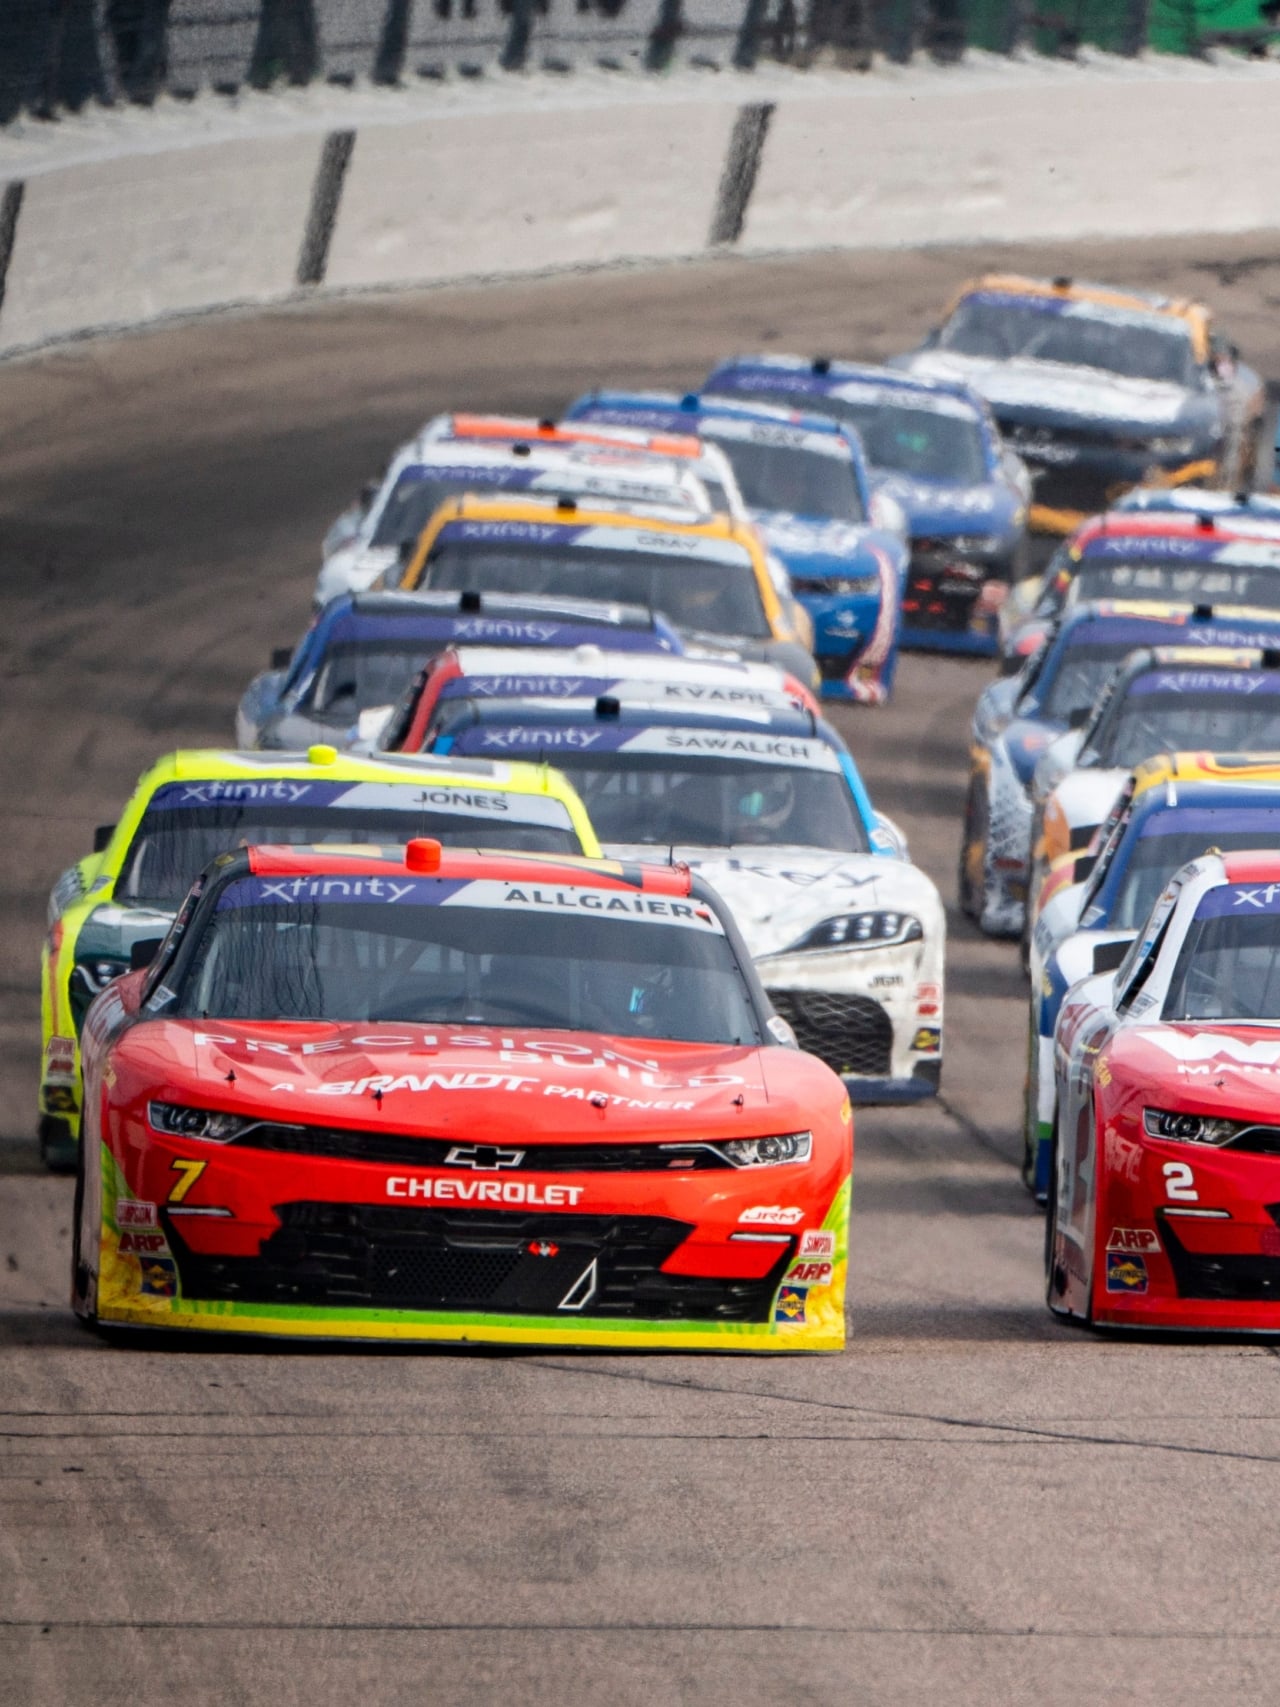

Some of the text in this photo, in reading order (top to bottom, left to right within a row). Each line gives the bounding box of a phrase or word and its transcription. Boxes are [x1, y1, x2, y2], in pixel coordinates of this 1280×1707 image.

[452, 620, 558, 641] xfinity
[470, 677, 584, 697] xfinity
[1156, 674, 1266, 697] xfinity
[484, 727, 810, 760] xfinity SAWALICH
[180, 778, 509, 812] xfinity JONES
[259, 877, 695, 921] xfinity ALLGAIER
[194, 1032, 661, 1074] PRECISION
[499, 1050, 746, 1090] BUILD
[270, 1072, 697, 1111] A BRANDT PARTNER
[168, 1159, 209, 1202] 7
[385, 1176, 585, 1206] CHEVROLET
[1162, 1161, 1199, 1201] 2
[119, 1232, 166, 1252] ARP
[1109, 1229, 1156, 1249] ARP
[786, 1262, 832, 1281] ARP
